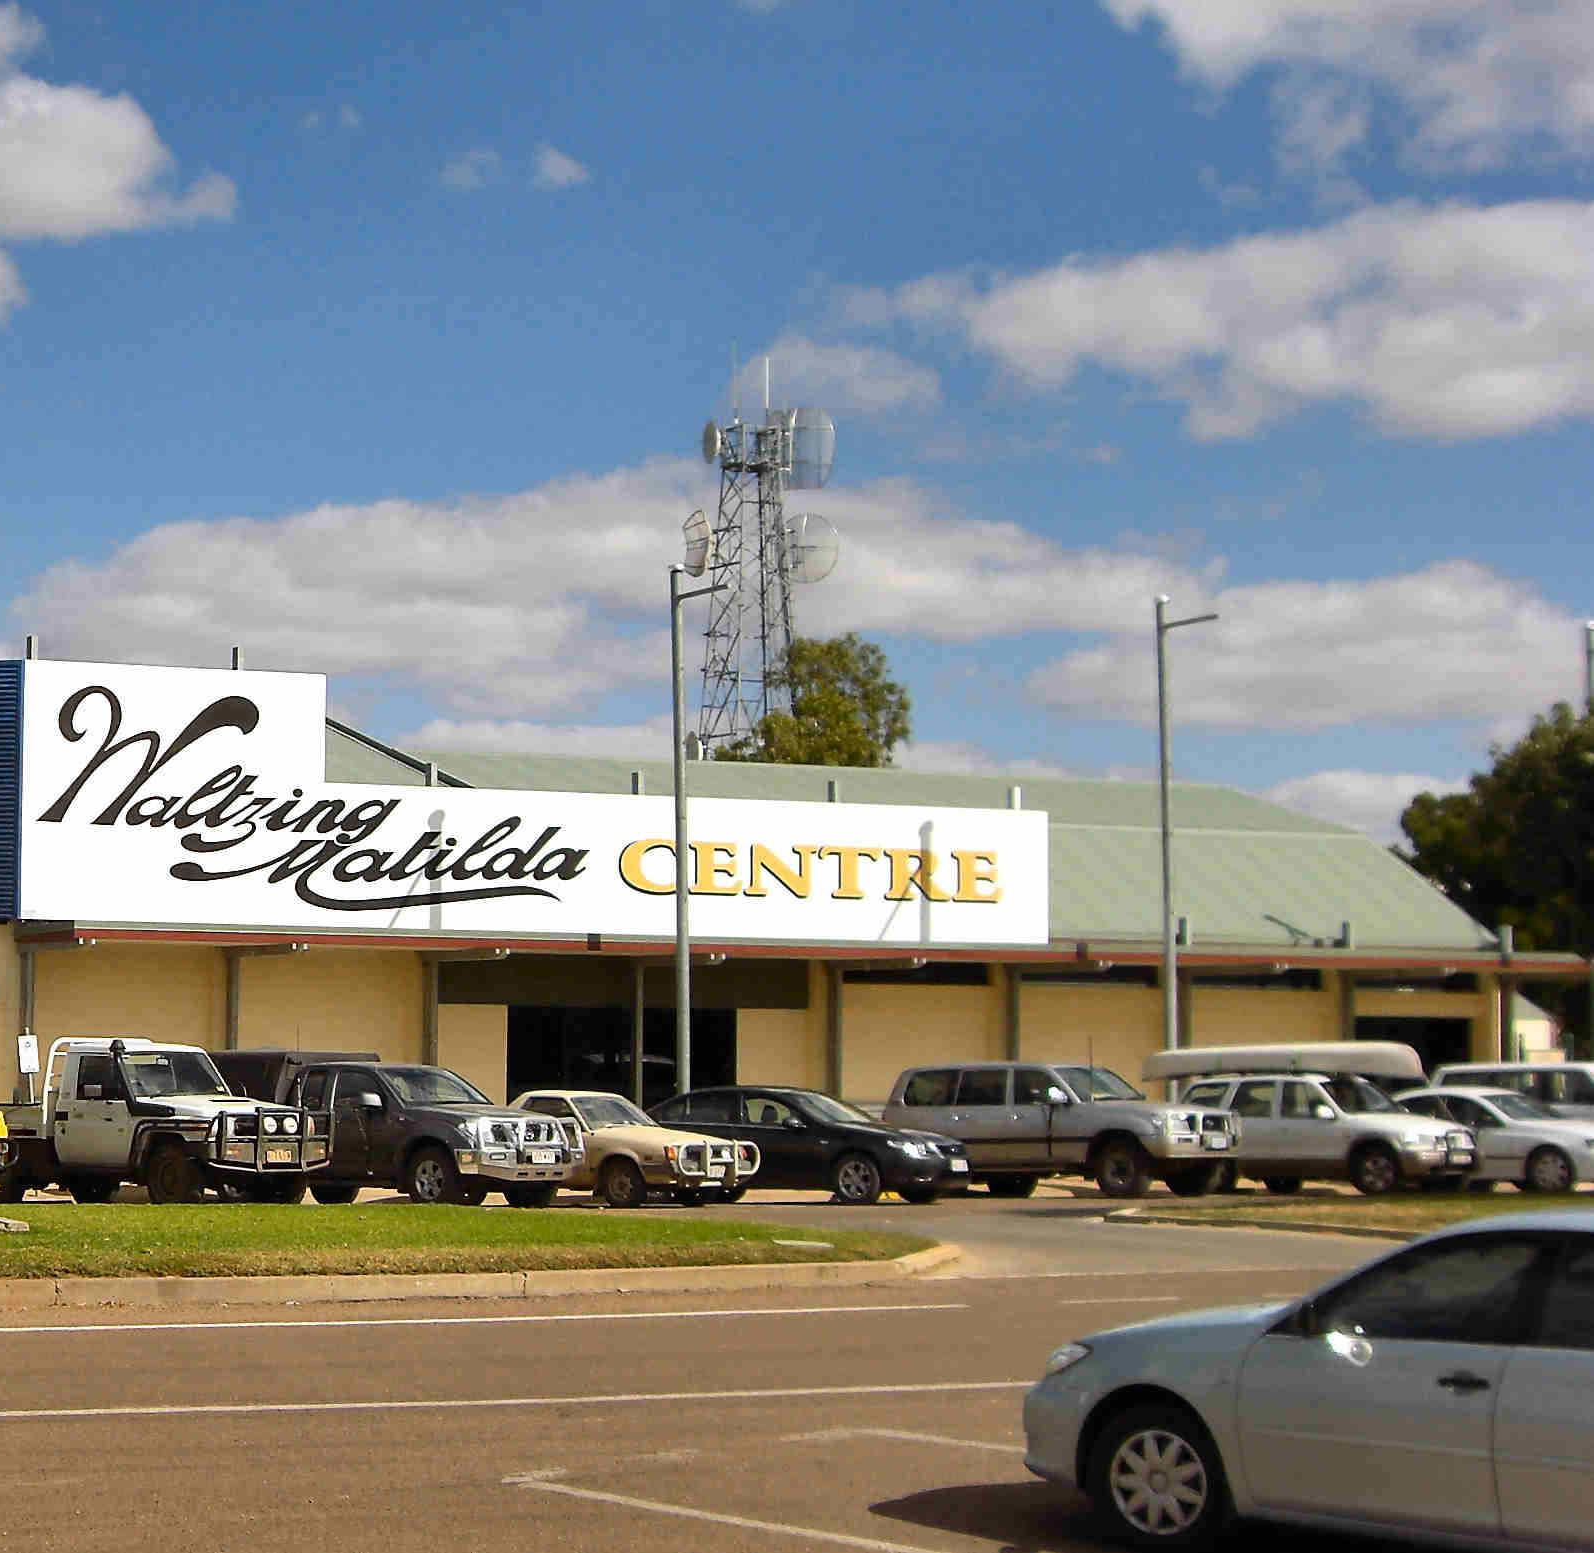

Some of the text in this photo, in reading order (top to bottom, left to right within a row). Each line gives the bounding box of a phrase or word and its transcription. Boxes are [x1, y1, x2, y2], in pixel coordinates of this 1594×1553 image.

[37, 686, 402, 853] Waltzing
[170, 816, 1003, 911] Matilda CENTRE
